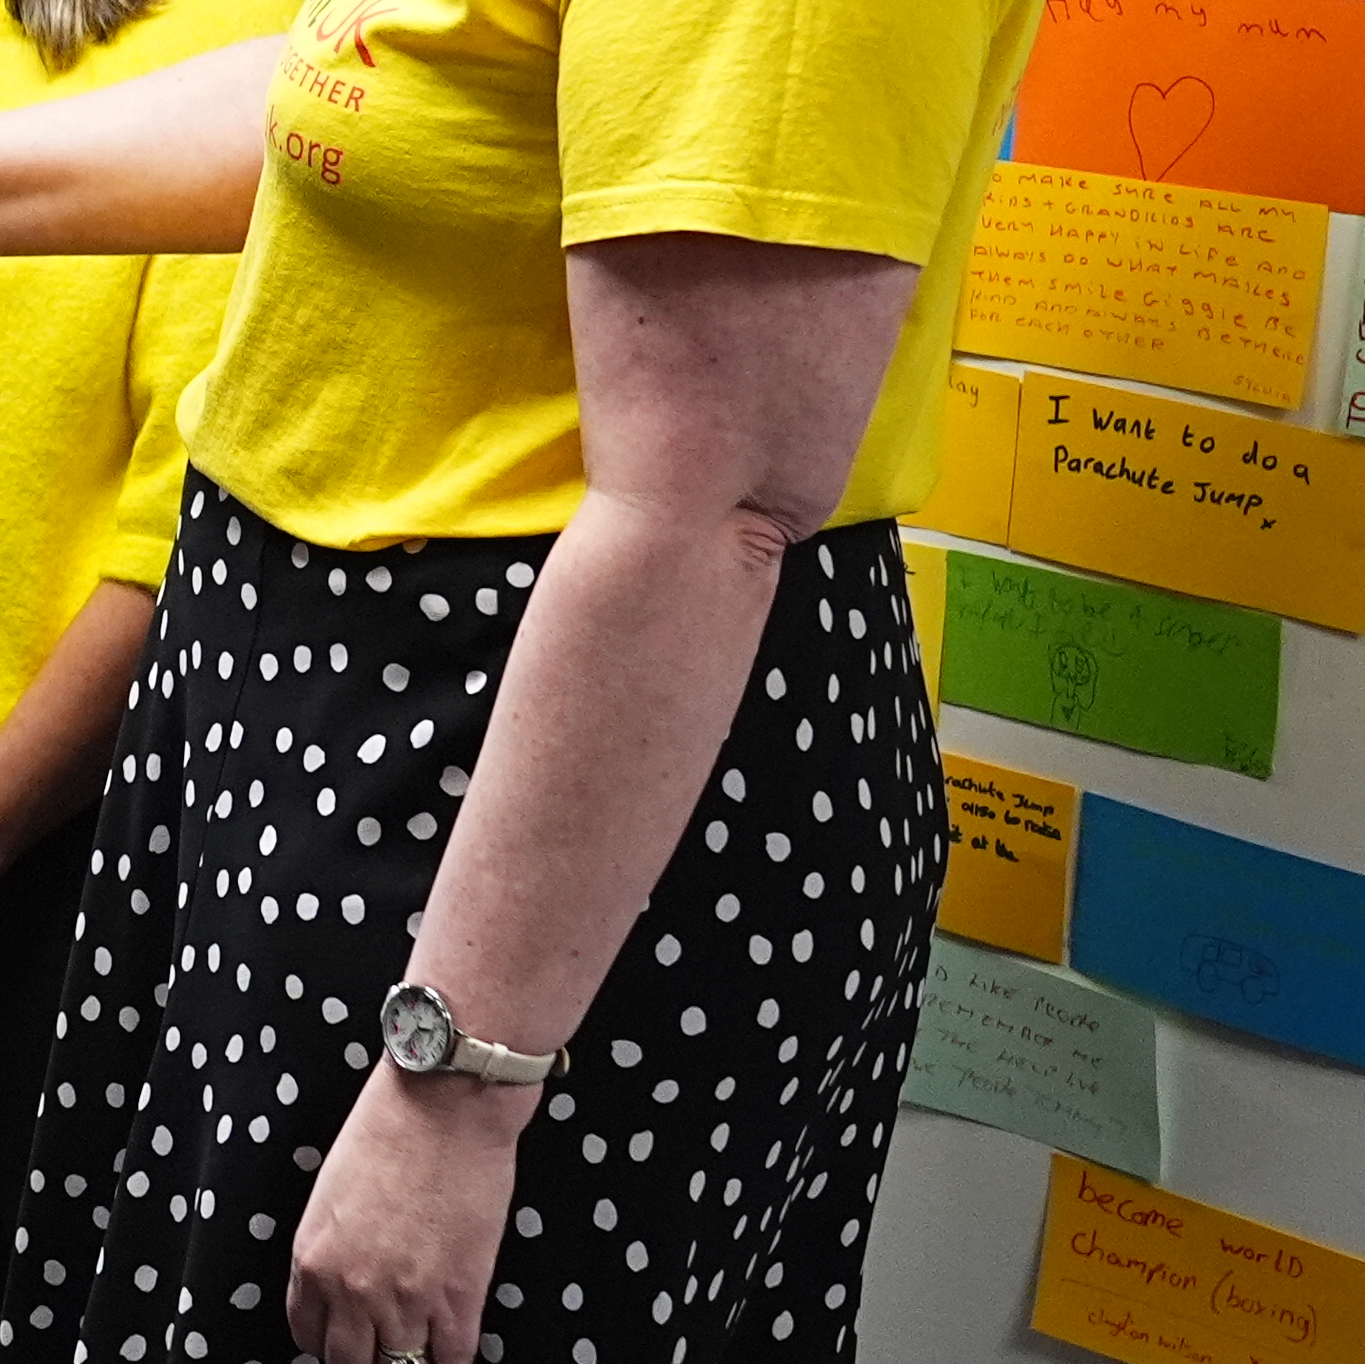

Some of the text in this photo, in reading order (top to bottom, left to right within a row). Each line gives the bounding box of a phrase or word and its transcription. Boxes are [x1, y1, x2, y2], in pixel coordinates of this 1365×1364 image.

[1047, 395, 1312, 486] I to do a
[1054, 445, 1176, 496] Parachute
[1078, 1170, 1184, 1238] become
